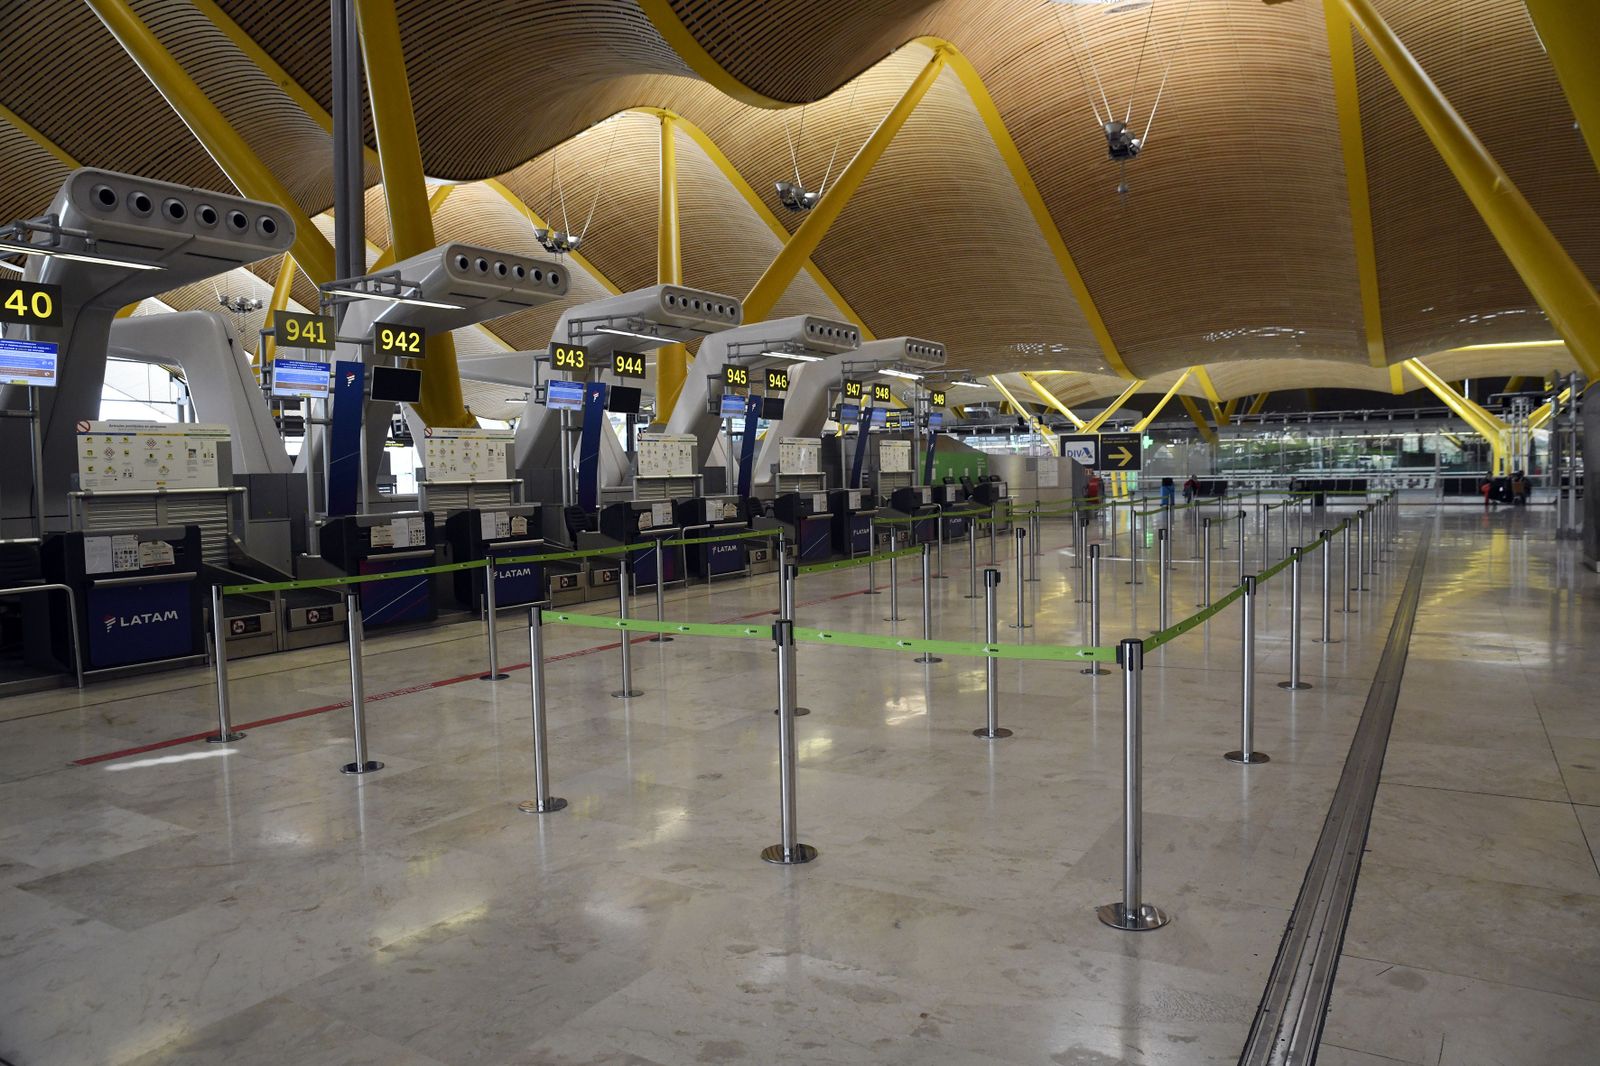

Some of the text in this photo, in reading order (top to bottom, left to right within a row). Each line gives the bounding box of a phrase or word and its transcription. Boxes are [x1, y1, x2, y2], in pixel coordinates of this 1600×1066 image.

[285, 318, 327, 344] 941
[381, 329, 420, 353] 942
[556, 348, 584, 368] 943
[616, 356, 643, 374] 944
[727, 368, 747, 385] 945
[769, 373, 788, 388] 946
[846, 382, 860, 396] 947
[875, 387, 889, 400] 948
[933, 393, 945, 405] 949
[717, 544, 737, 553] LATAM
[499, 567, 531, 579] LATAM
[120, 610, 178, 627] LATAM
